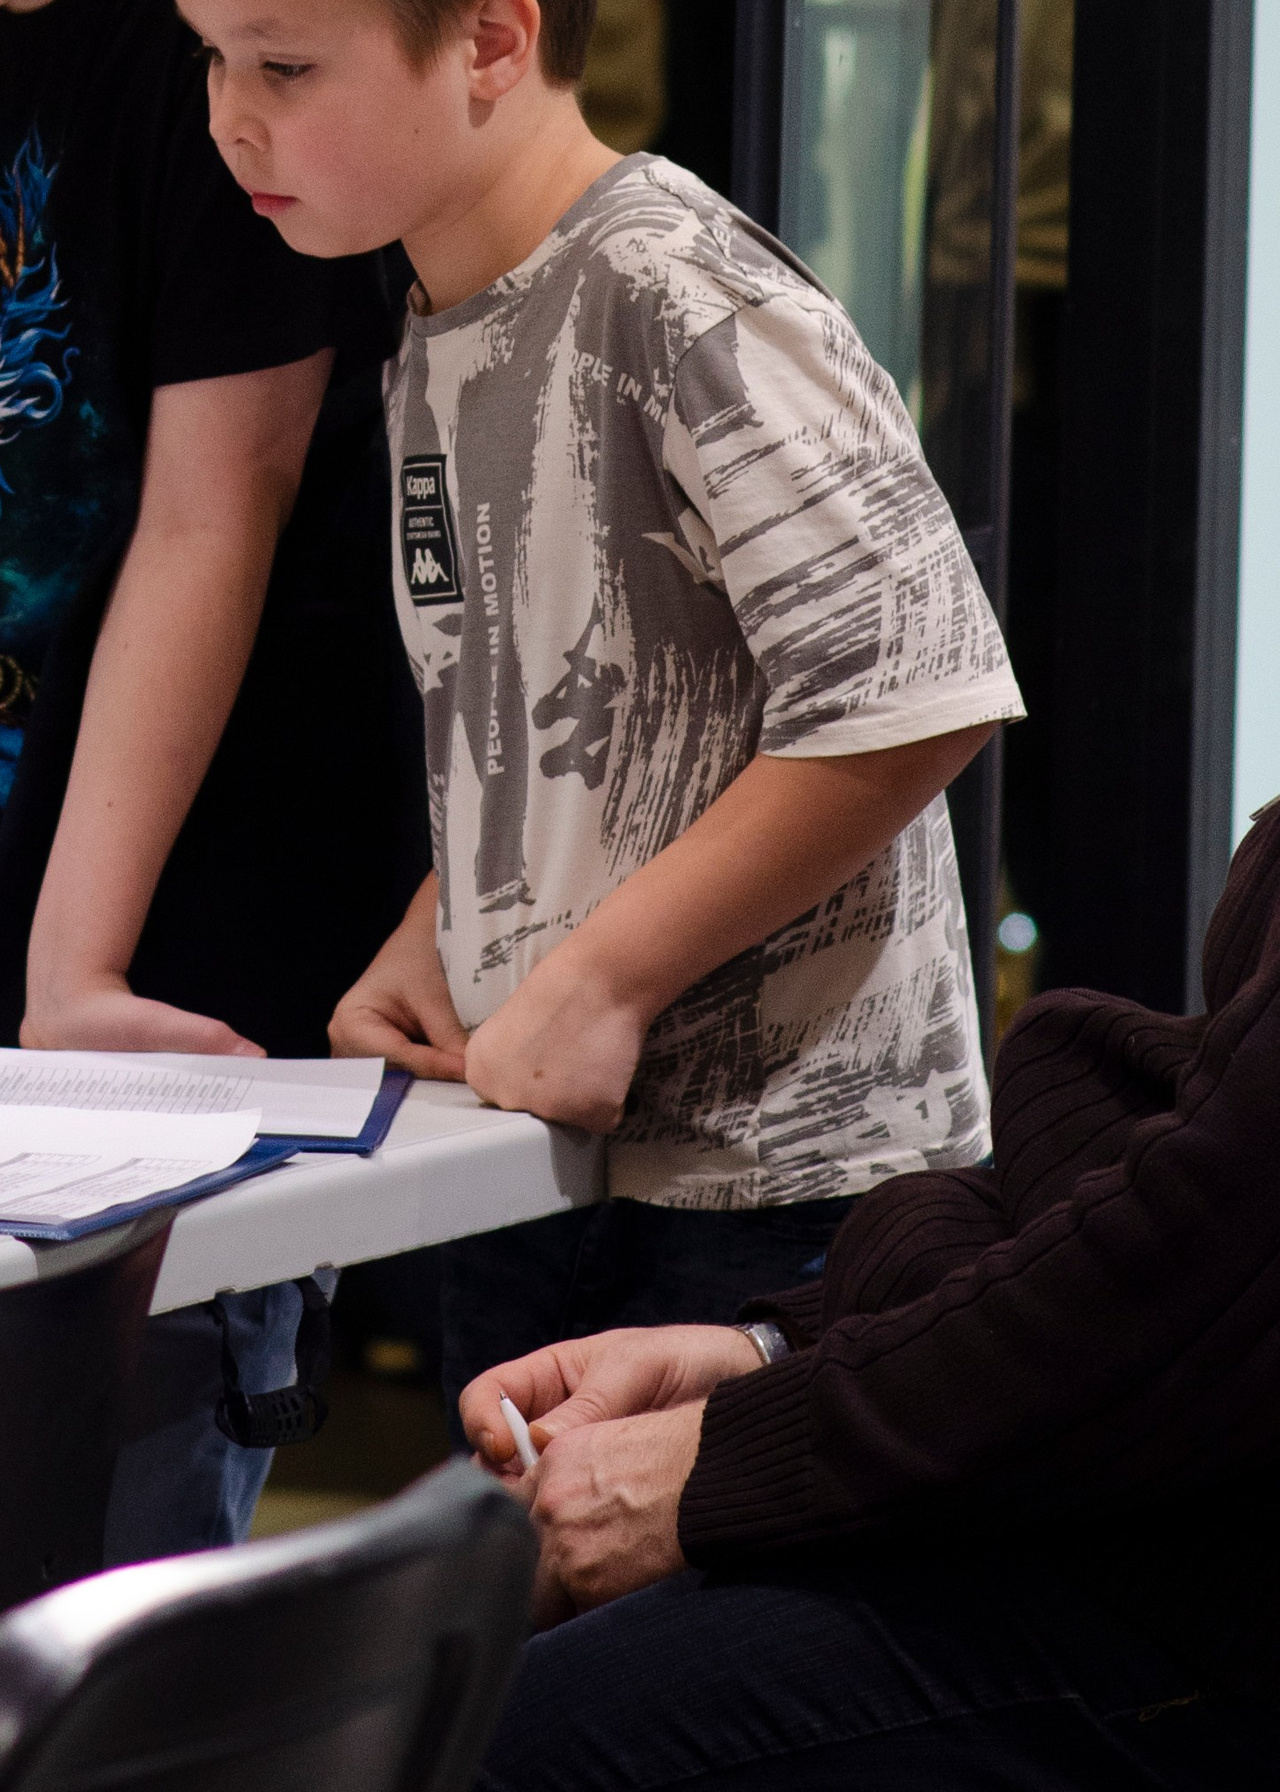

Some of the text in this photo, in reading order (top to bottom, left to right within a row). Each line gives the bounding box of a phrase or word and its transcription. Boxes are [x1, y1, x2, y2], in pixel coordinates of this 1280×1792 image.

[616, 372, 642, 402] IN
[406, 475, 436, 500] Kappa
[476, 502, 498, 616] MOTION
[488, 625, 500, 655] IN
